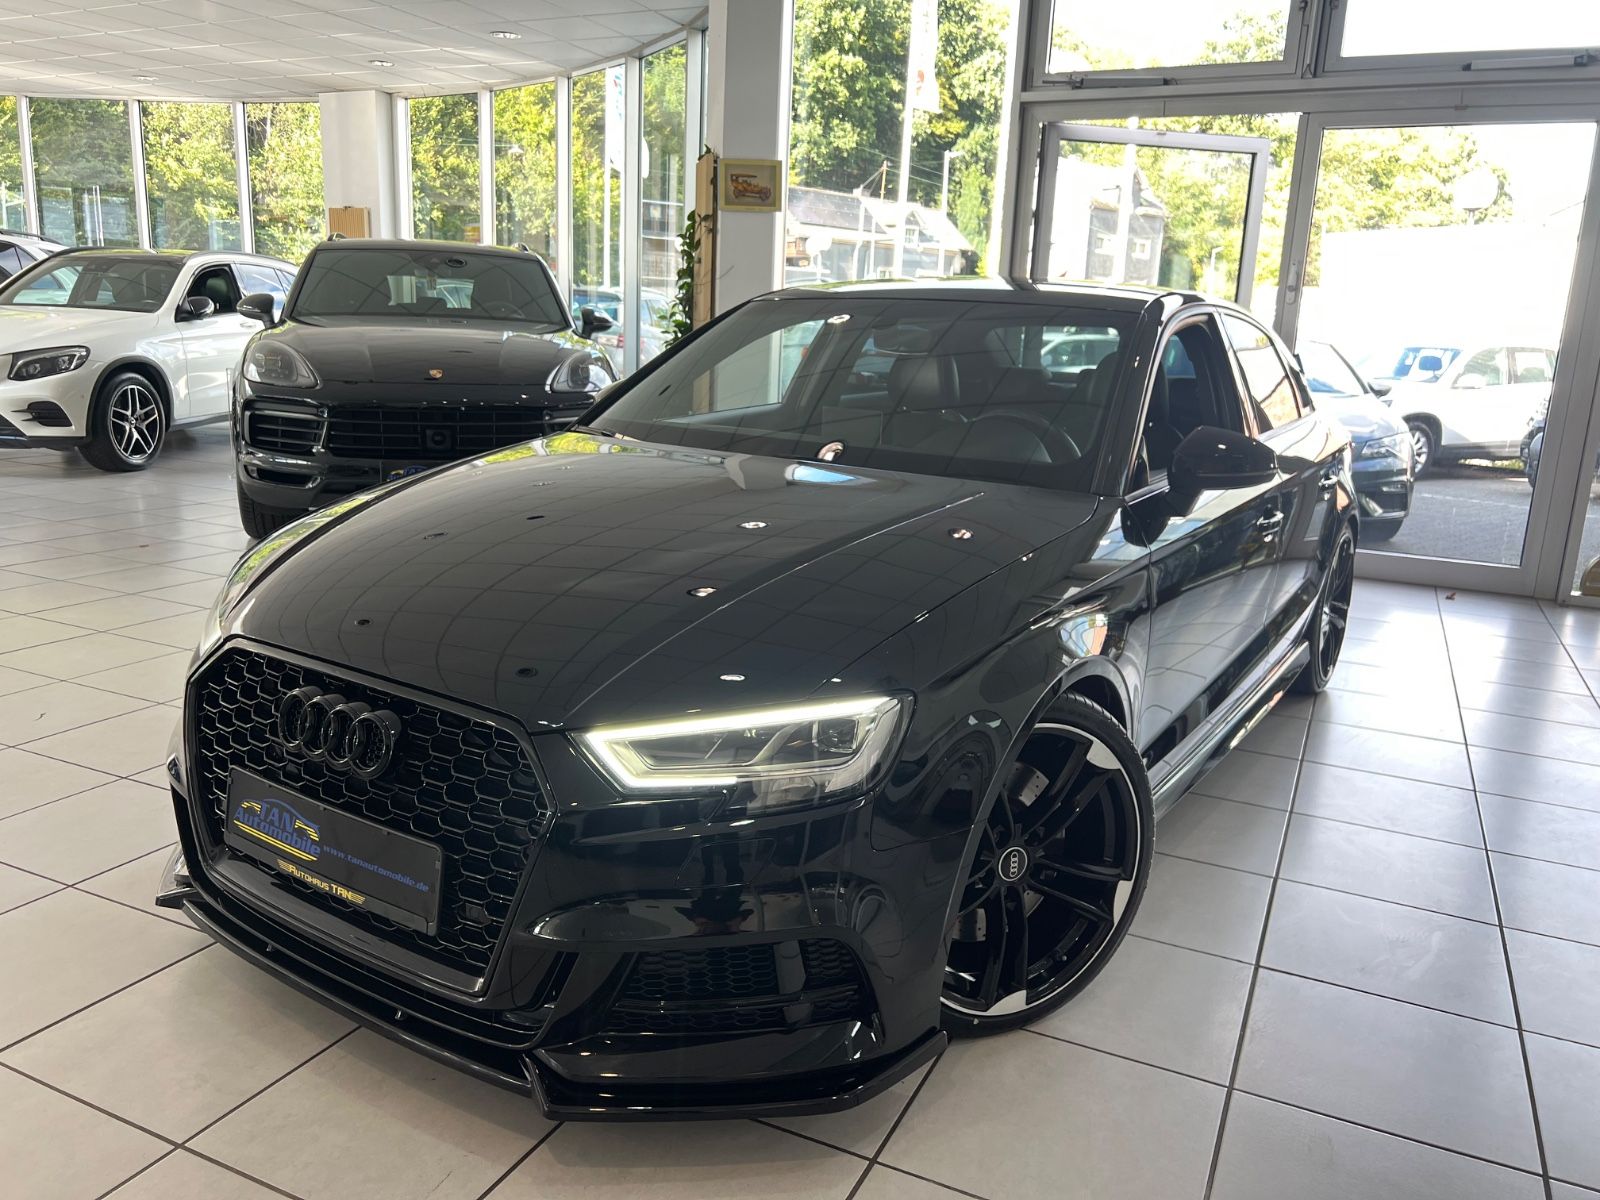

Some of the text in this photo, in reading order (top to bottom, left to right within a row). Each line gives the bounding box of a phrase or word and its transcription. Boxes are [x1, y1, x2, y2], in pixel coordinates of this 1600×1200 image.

[233, 807, 321, 857] Automobile
[260, 801, 296, 833] TAN
[323, 845, 429, 892] www.tanautomobile.de
[330, 883, 352, 900] TAN
